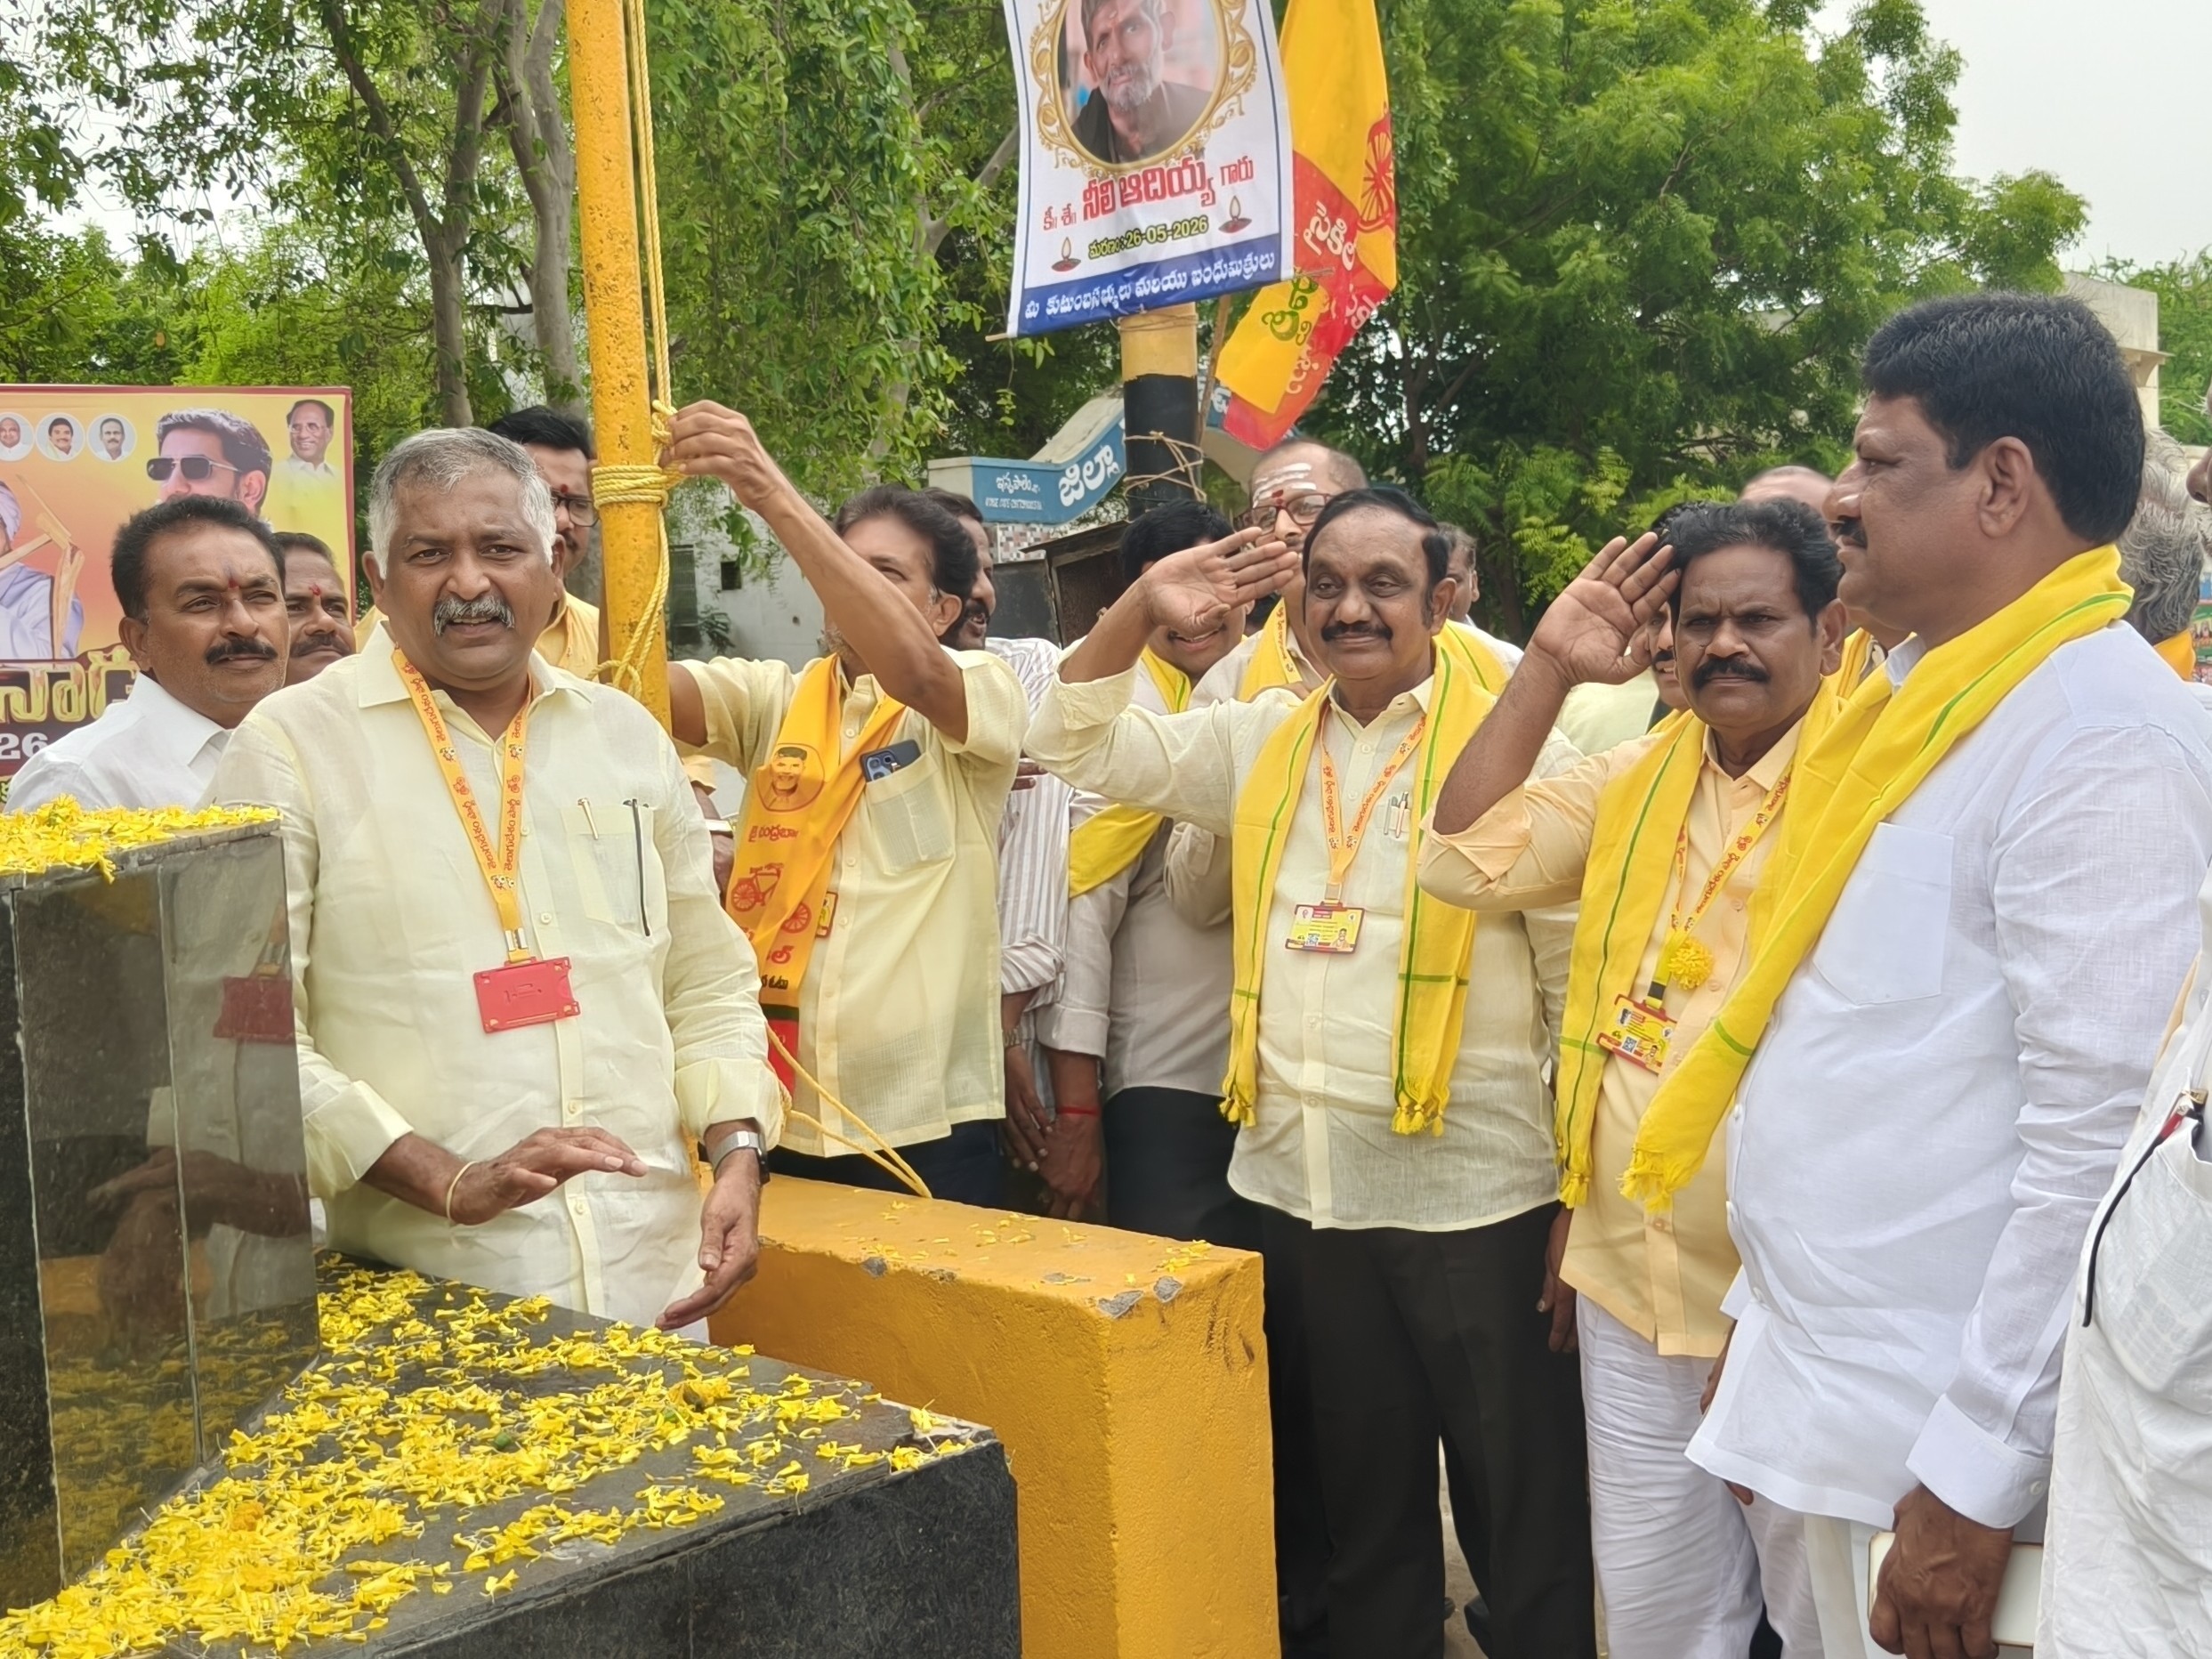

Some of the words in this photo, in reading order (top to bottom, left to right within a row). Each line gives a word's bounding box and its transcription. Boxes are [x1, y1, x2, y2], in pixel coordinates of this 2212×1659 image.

[1220, 156, 1254, 186] గారు
[1059, 444, 1120, 507] జిల్లా
[505, 820, 516, 871] తెలుగుదేశం
